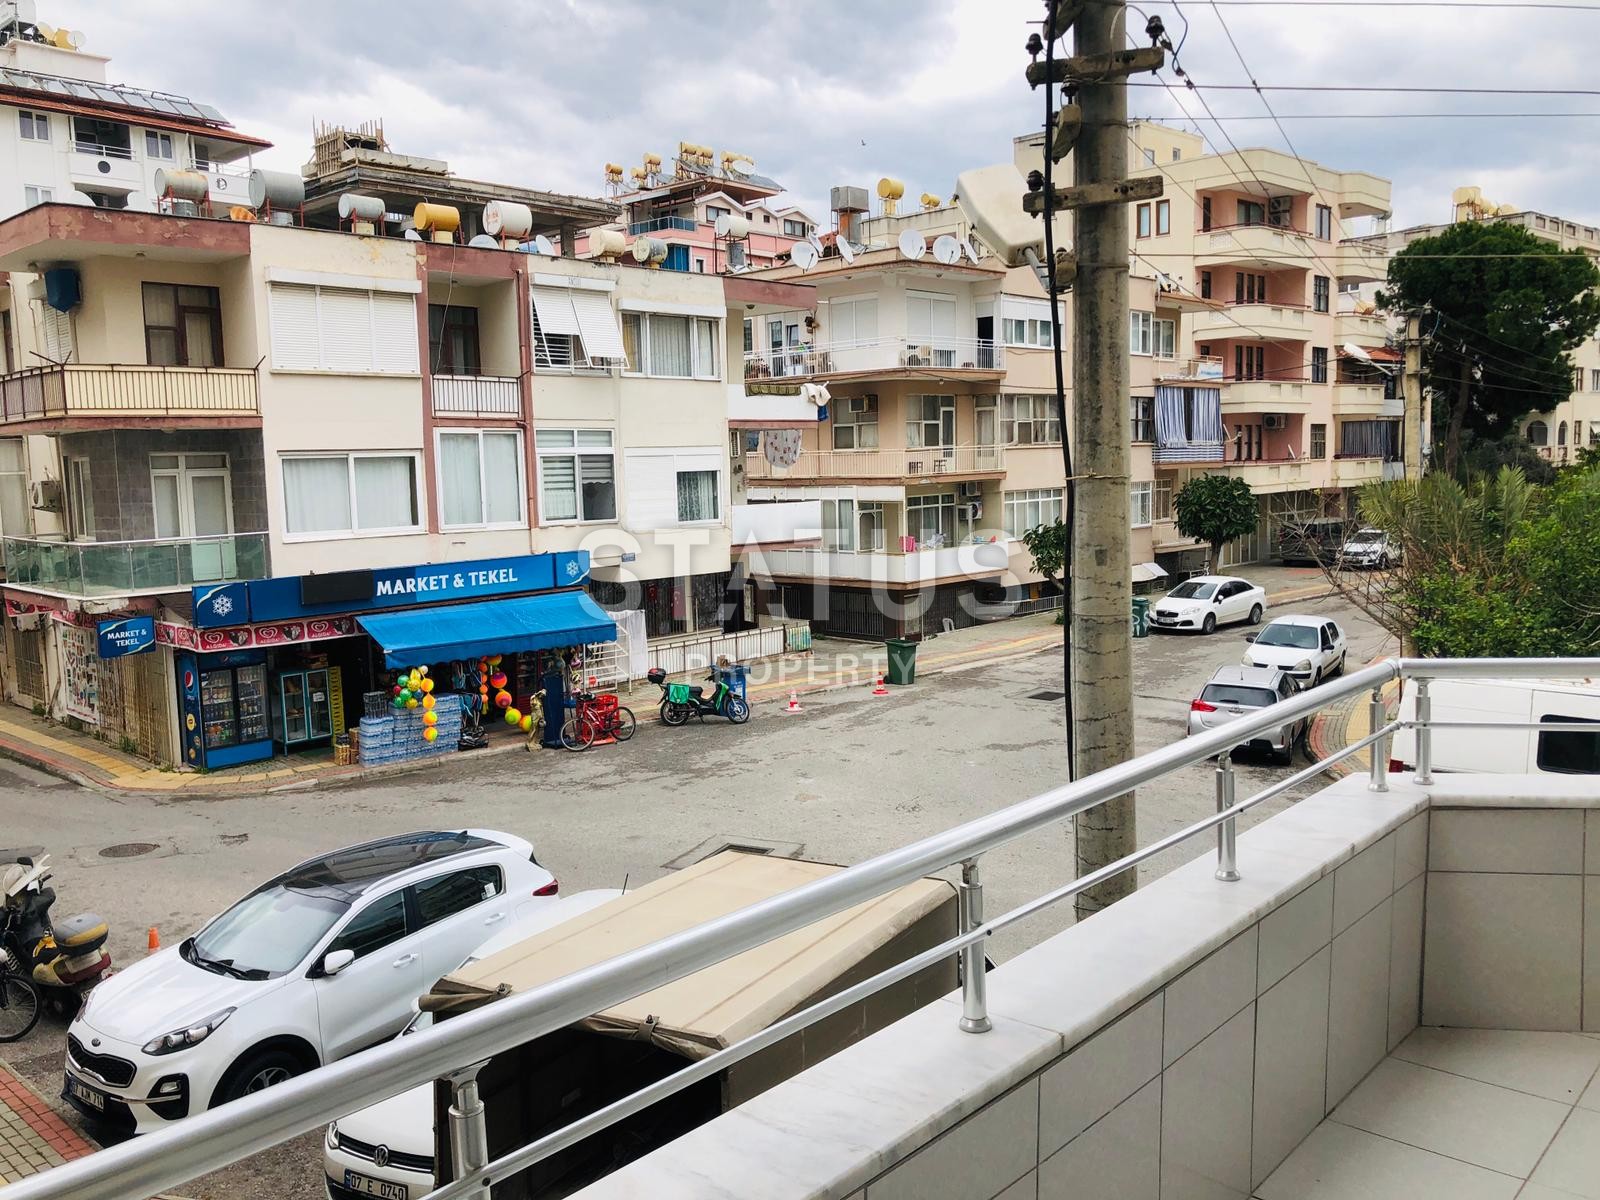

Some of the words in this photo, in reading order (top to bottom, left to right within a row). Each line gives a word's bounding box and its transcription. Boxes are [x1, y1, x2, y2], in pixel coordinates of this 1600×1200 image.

[376, 574, 449, 596] MARKET
[453, 573, 465, 588] &
[468, 568, 518, 586] TEKEL
[107, 629, 139, 640] MARKET
[141, 628, 147, 636] &
[115, 638, 140, 647] TEKEL
[351, 1175, 362, 1189] 07
[367, 1179, 374, 1193] E
[380, 1183, 405, 1200] 0740
